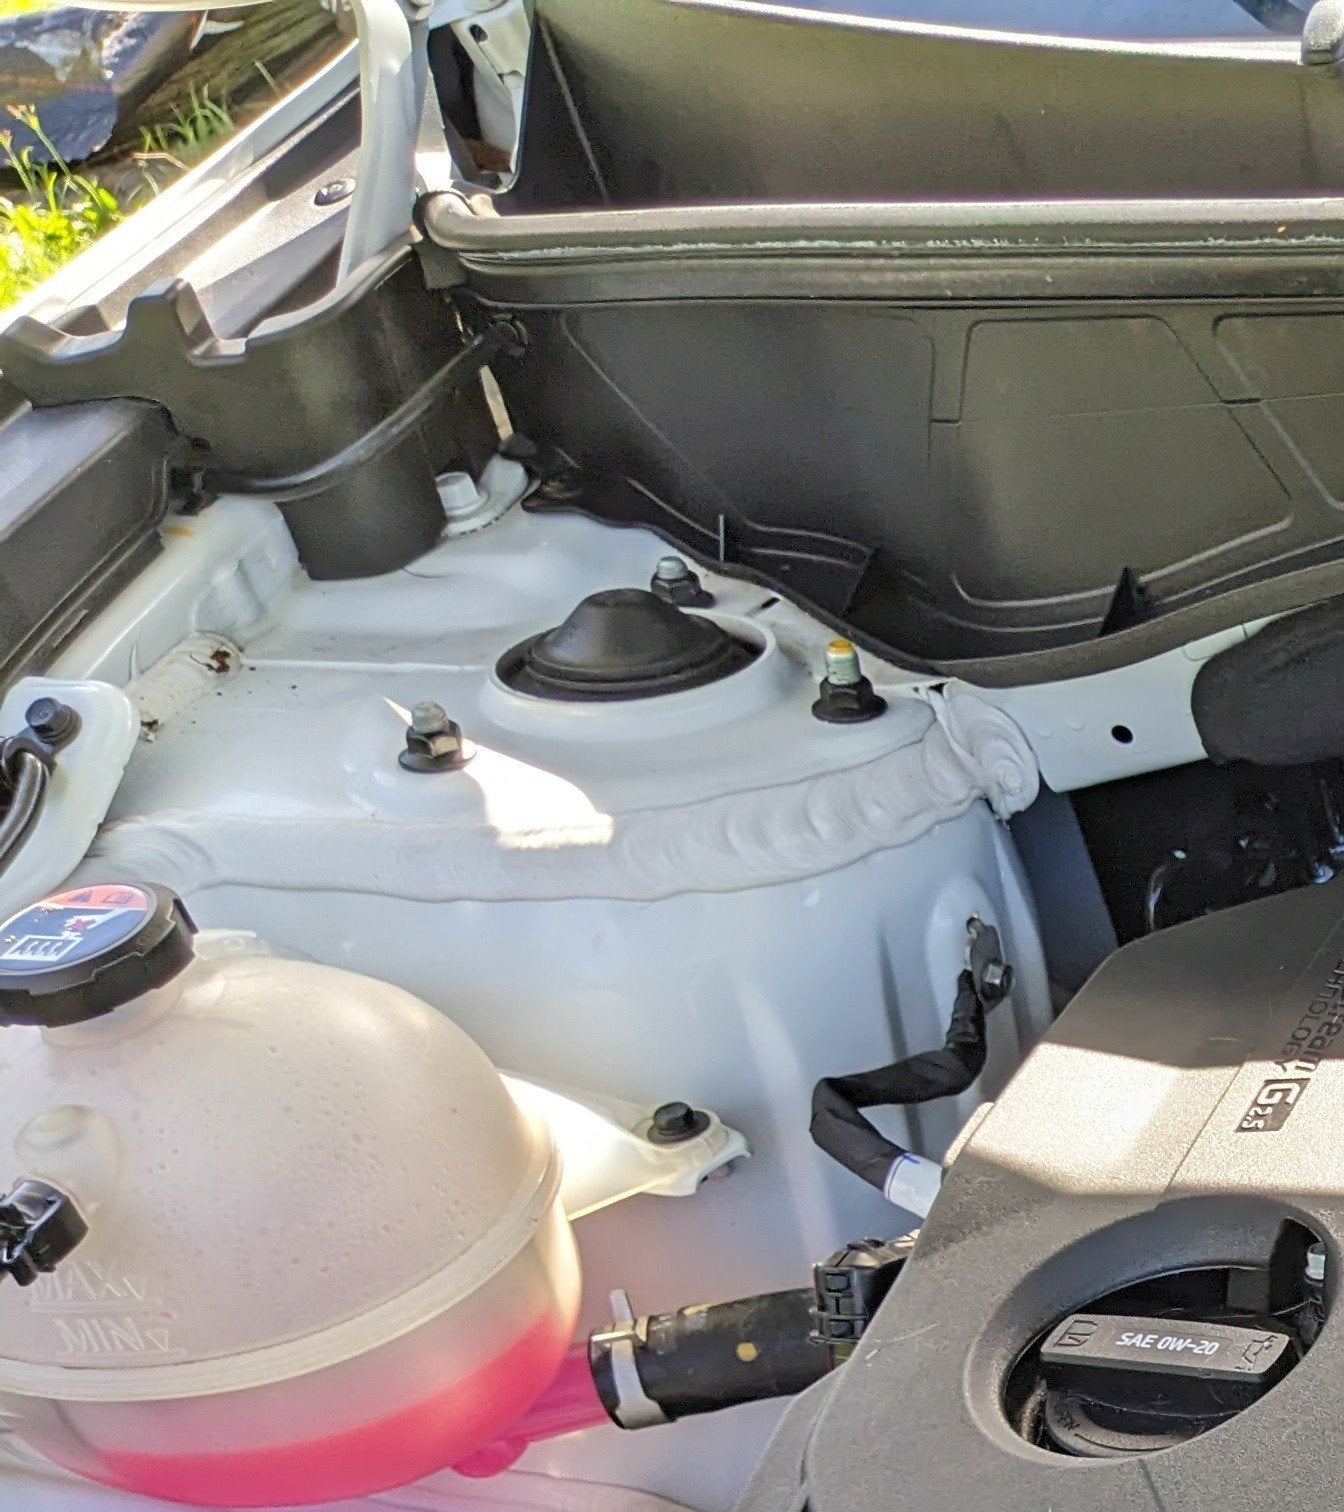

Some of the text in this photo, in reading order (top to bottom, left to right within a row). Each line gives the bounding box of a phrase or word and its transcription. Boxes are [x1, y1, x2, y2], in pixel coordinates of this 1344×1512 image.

[52, 1316, 145, 1351] MIN
[1116, 1332, 1220, 1355] SAE 0W-20
